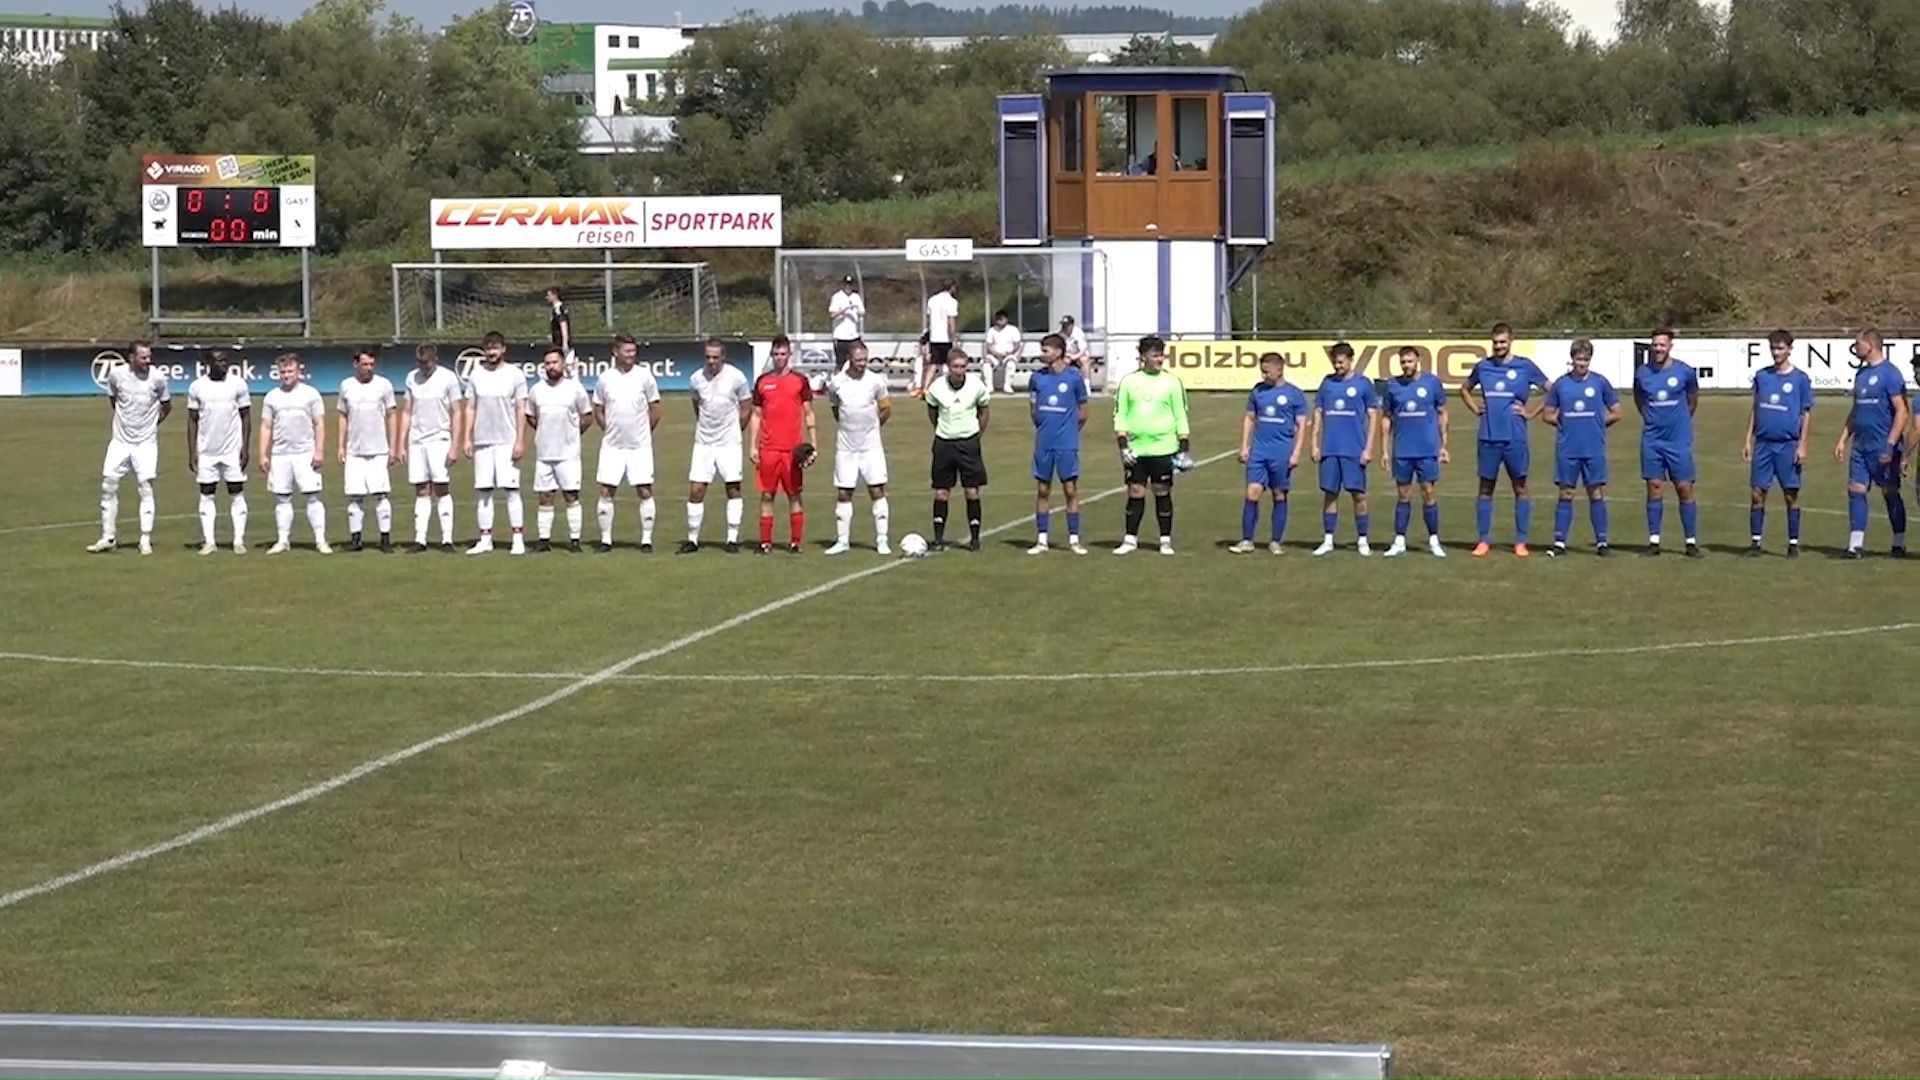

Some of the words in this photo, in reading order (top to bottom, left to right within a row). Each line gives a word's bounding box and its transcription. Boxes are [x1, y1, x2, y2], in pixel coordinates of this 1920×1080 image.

[188, 190, 202, 212] 0
[254, 190, 268, 212] 0
[436, 203, 640, 226] CERMAK
[651, 212, 776, 231] SPORTPARK
[253, 228, 278, 240] min
[577, 227, 635, 243] reisen
[919, 244, 958, 257] GAST
[1164, 345, 1307, 369] Holzbu
[156, 363, 190, 380] ee.
